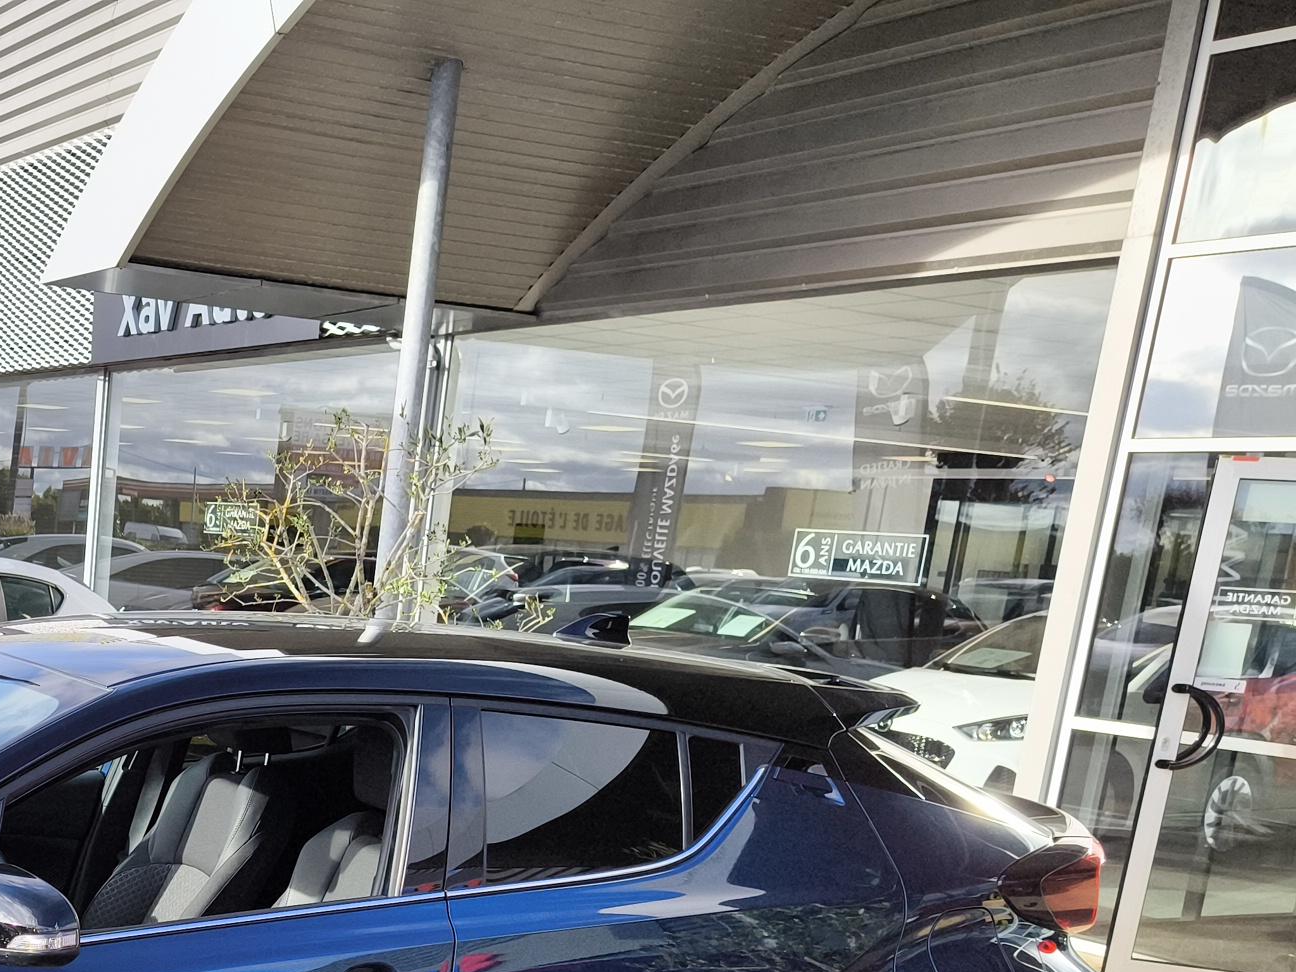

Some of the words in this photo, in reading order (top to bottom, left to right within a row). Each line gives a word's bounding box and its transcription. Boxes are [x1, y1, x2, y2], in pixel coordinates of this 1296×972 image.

[795, 533, 816, 568] 6
[818, 537, 832, 566] ANS
[842, 540, 917, 558] GARANTIE
[846, 558, 904, 576] MAZDA
